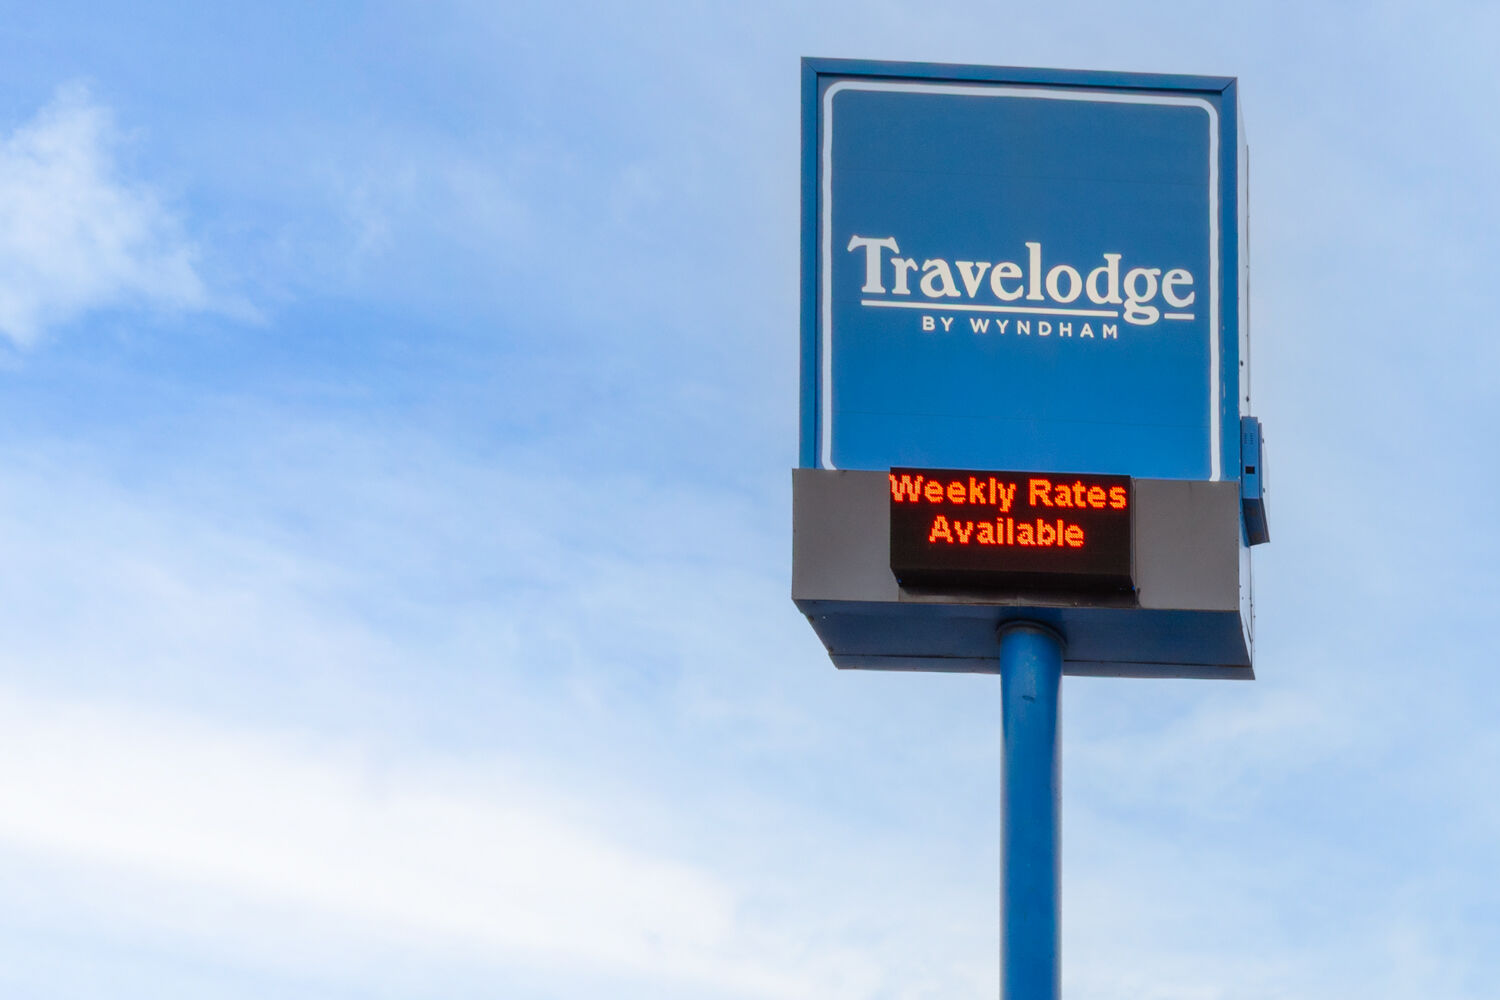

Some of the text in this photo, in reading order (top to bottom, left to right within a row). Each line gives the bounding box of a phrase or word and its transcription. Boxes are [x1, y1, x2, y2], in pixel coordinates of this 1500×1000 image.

[848, 235, 1196, 326] Travelodge
[922, 315, 1119, 340] BY WYNDHAM
[889, 473, 1127, 513] Weekly Rates
[928, 515, 1085, 548] Available
